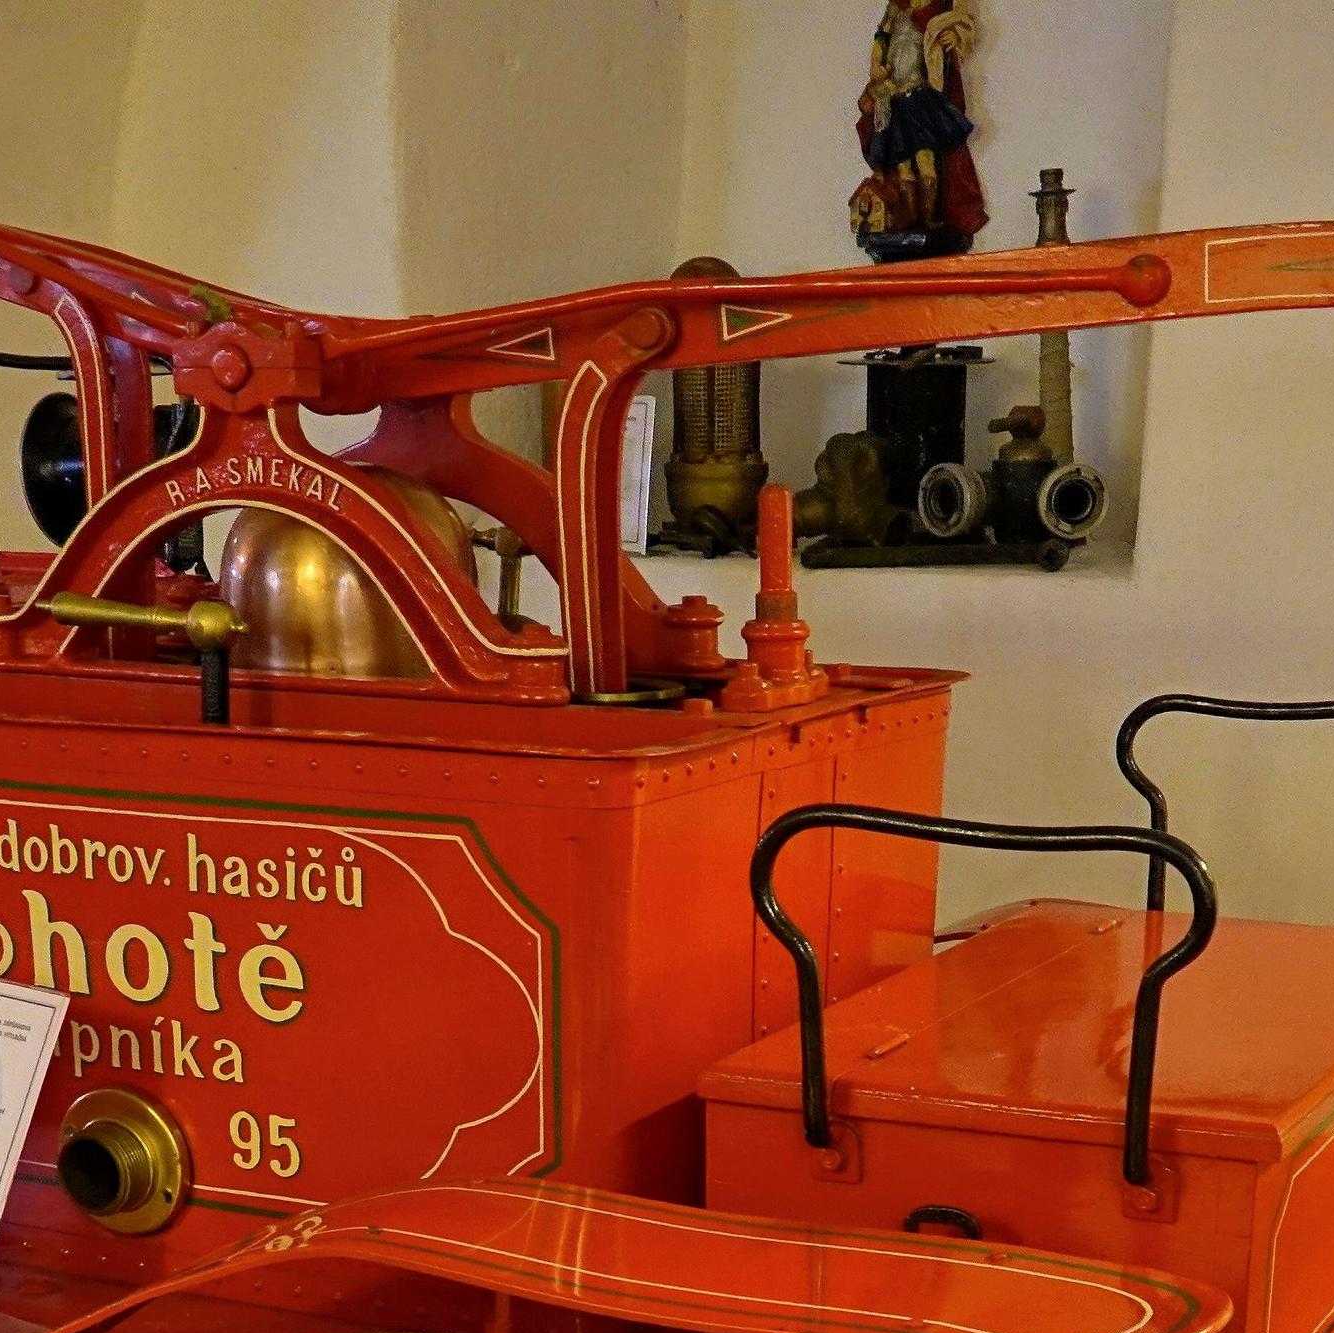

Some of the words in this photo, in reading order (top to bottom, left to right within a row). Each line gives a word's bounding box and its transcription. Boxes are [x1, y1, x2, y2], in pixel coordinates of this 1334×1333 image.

[227, 456, 340, 511] SMEKAL
[187, 832, 363, 908] hasičů
[53, 1016, 244, 1083] pníka
[229, 1110, 301, 1178] 95
